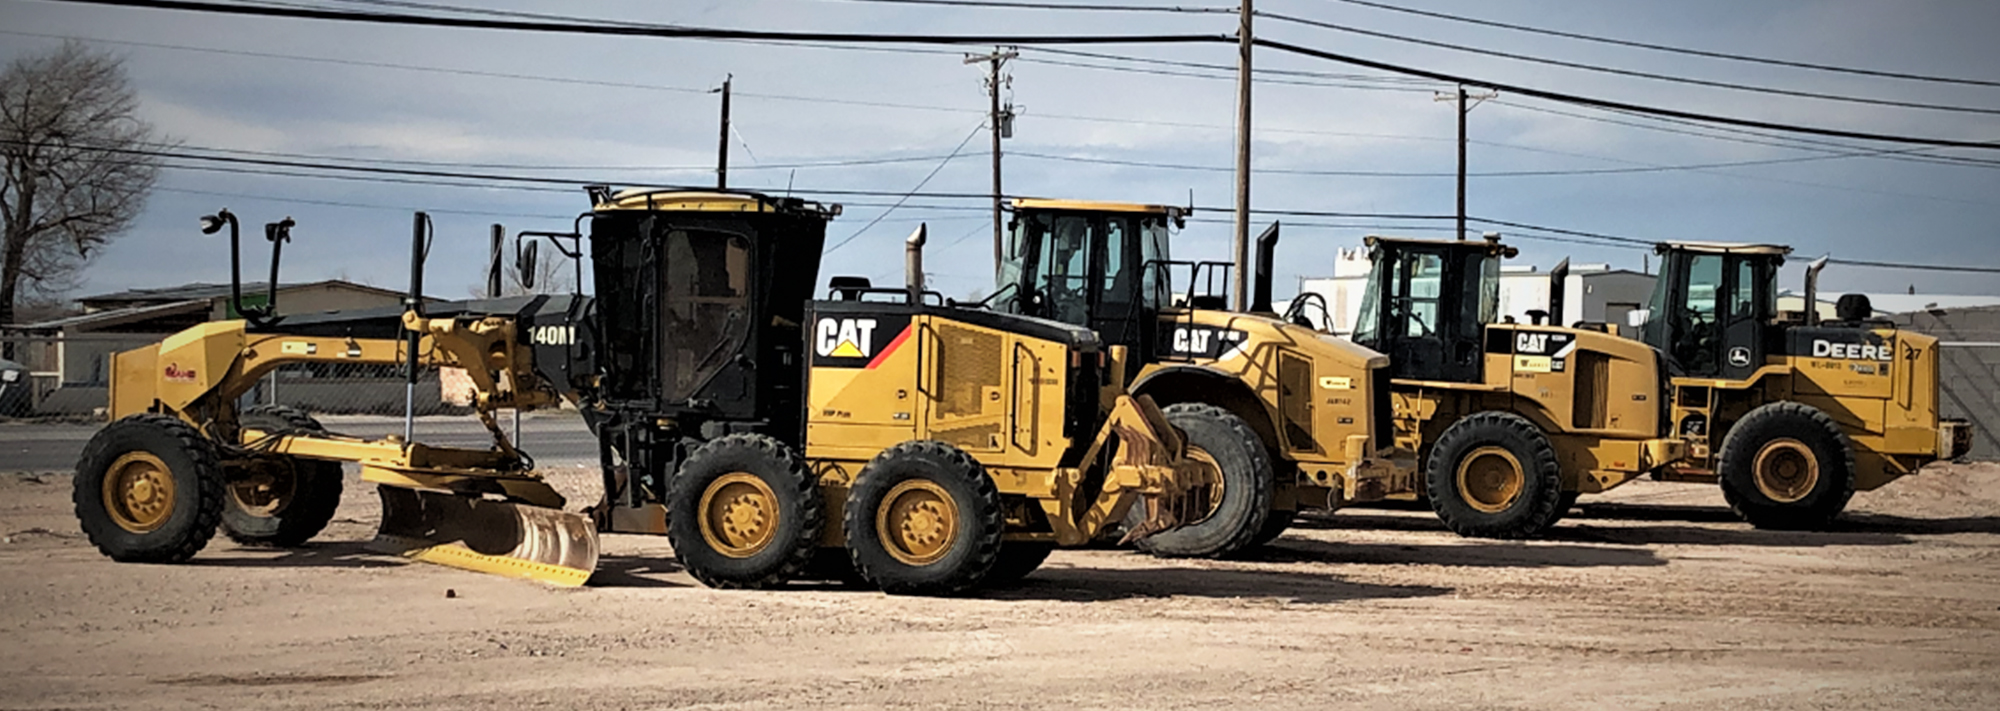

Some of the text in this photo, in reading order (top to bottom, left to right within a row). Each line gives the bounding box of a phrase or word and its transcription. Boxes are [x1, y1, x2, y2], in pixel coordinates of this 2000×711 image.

[527, 325, 575, 345] 140M
[816, 317, 877, 358] CAT
[1173, 328, 1212, 353] CAT
[1517, 332, 1549, 353] CAT
[1813, 339, 1893, 361] DEERE
[1904, 348, 1922, 361] 27
